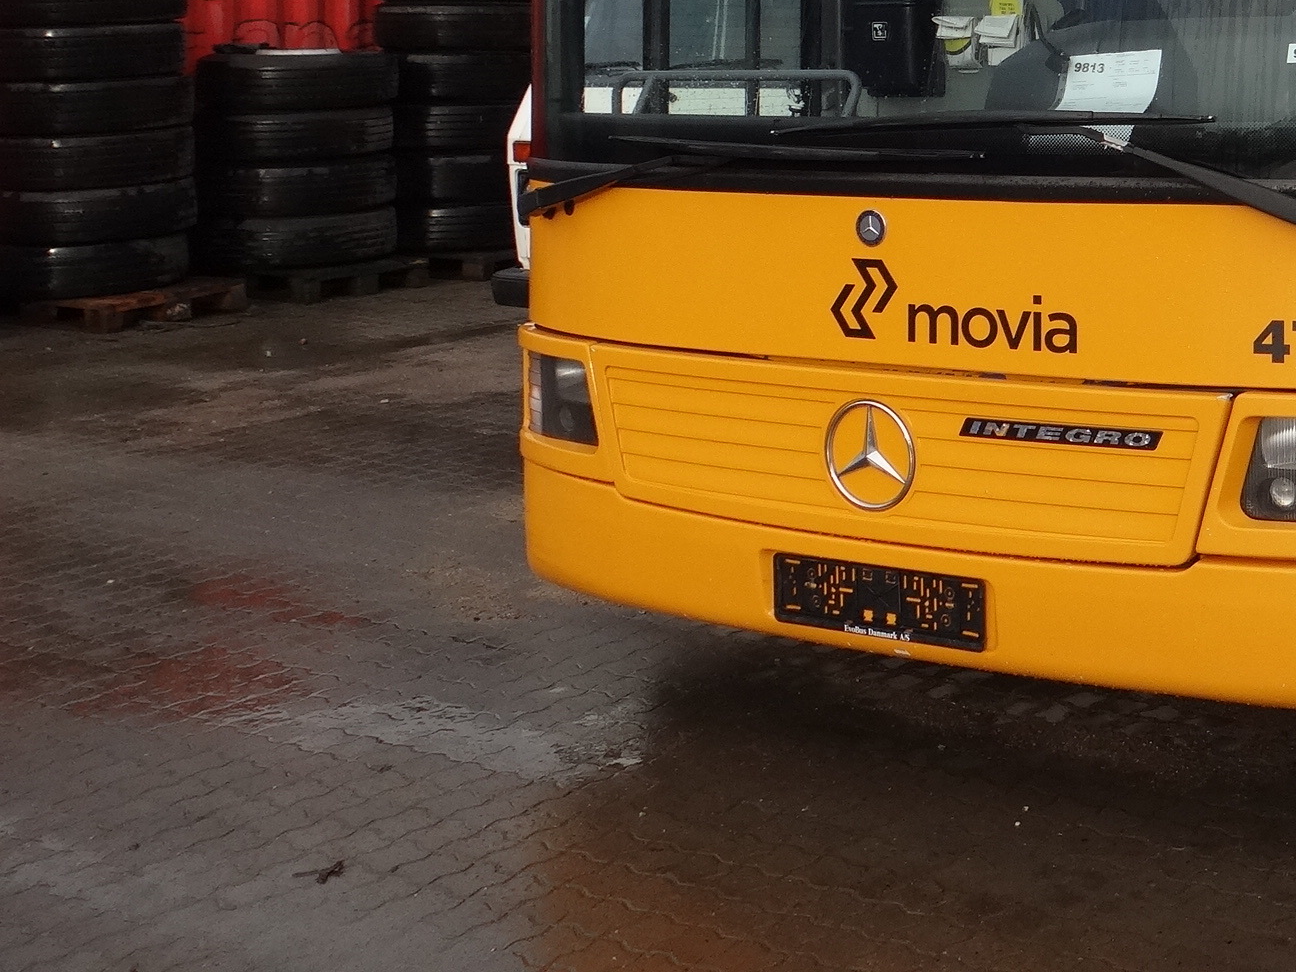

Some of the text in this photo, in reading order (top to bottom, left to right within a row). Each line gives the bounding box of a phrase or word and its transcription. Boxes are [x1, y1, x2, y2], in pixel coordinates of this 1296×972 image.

[1074, 62, 1105, 74] 9813
[907, 295, 1078, 354] movia
[969, 420, 1152, 447] INTEGRO
[844, 624, 911, 642] EvoBus Danmark A/S
